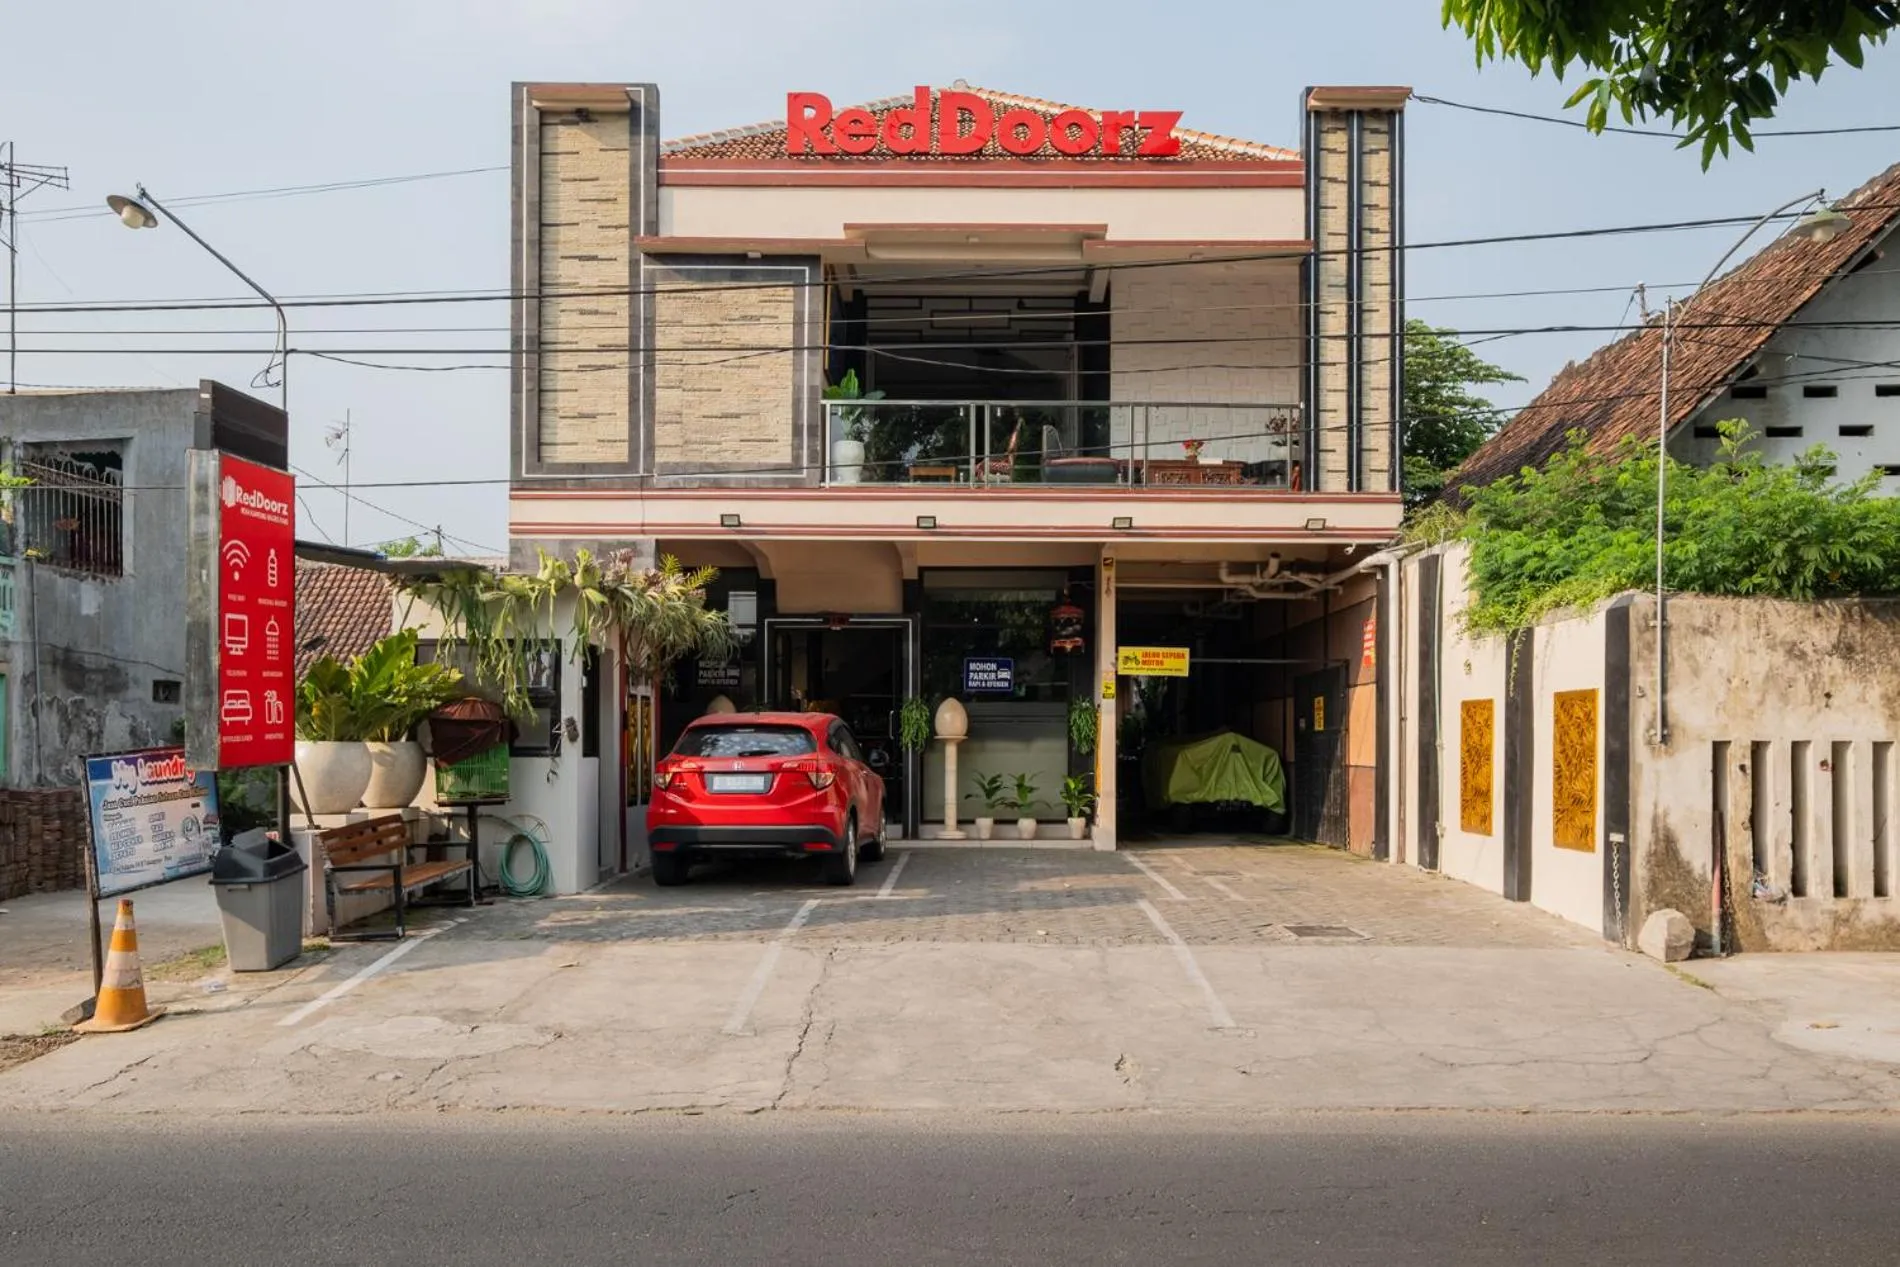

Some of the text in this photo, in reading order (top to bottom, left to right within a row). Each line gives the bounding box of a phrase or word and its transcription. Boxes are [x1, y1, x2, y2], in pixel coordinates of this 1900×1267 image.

[787, 85, 1184, 156] RedDoorz
[236, 484, 288, 516] RedDoorz
[969, 662, 997, 671] MOHON
[1141, 659, 1165, 667] MOTOR
[969, 672, 997, 681] PARKIR
